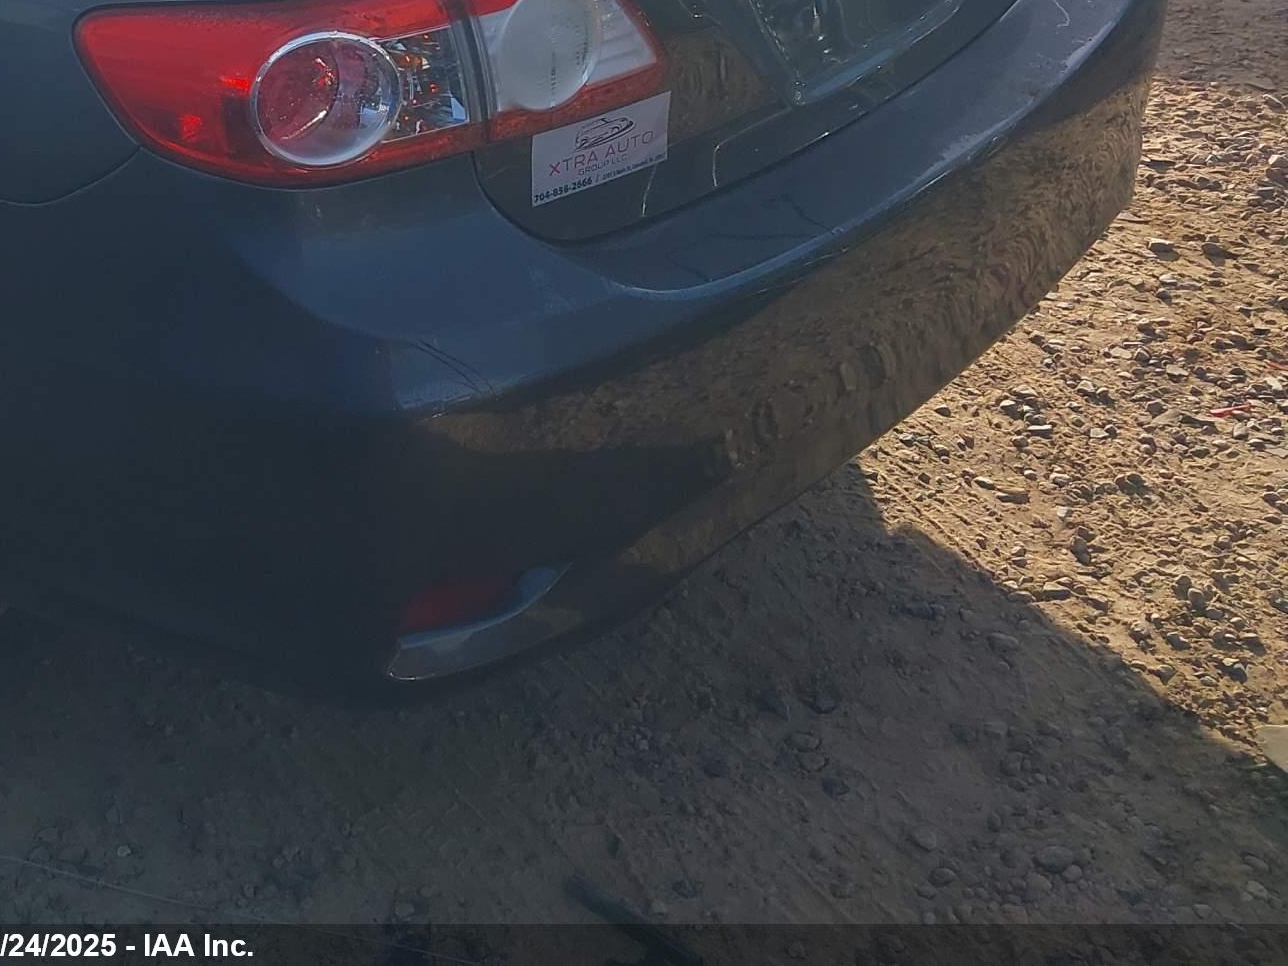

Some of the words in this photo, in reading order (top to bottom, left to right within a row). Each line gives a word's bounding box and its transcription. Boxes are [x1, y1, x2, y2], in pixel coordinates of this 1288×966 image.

[549, 150, 598, 176] XTRA
[605, 130, 654, 157] AUTO
[578, 159, 611, 176] GROUP
[611, 154, 628, 165] LLC
